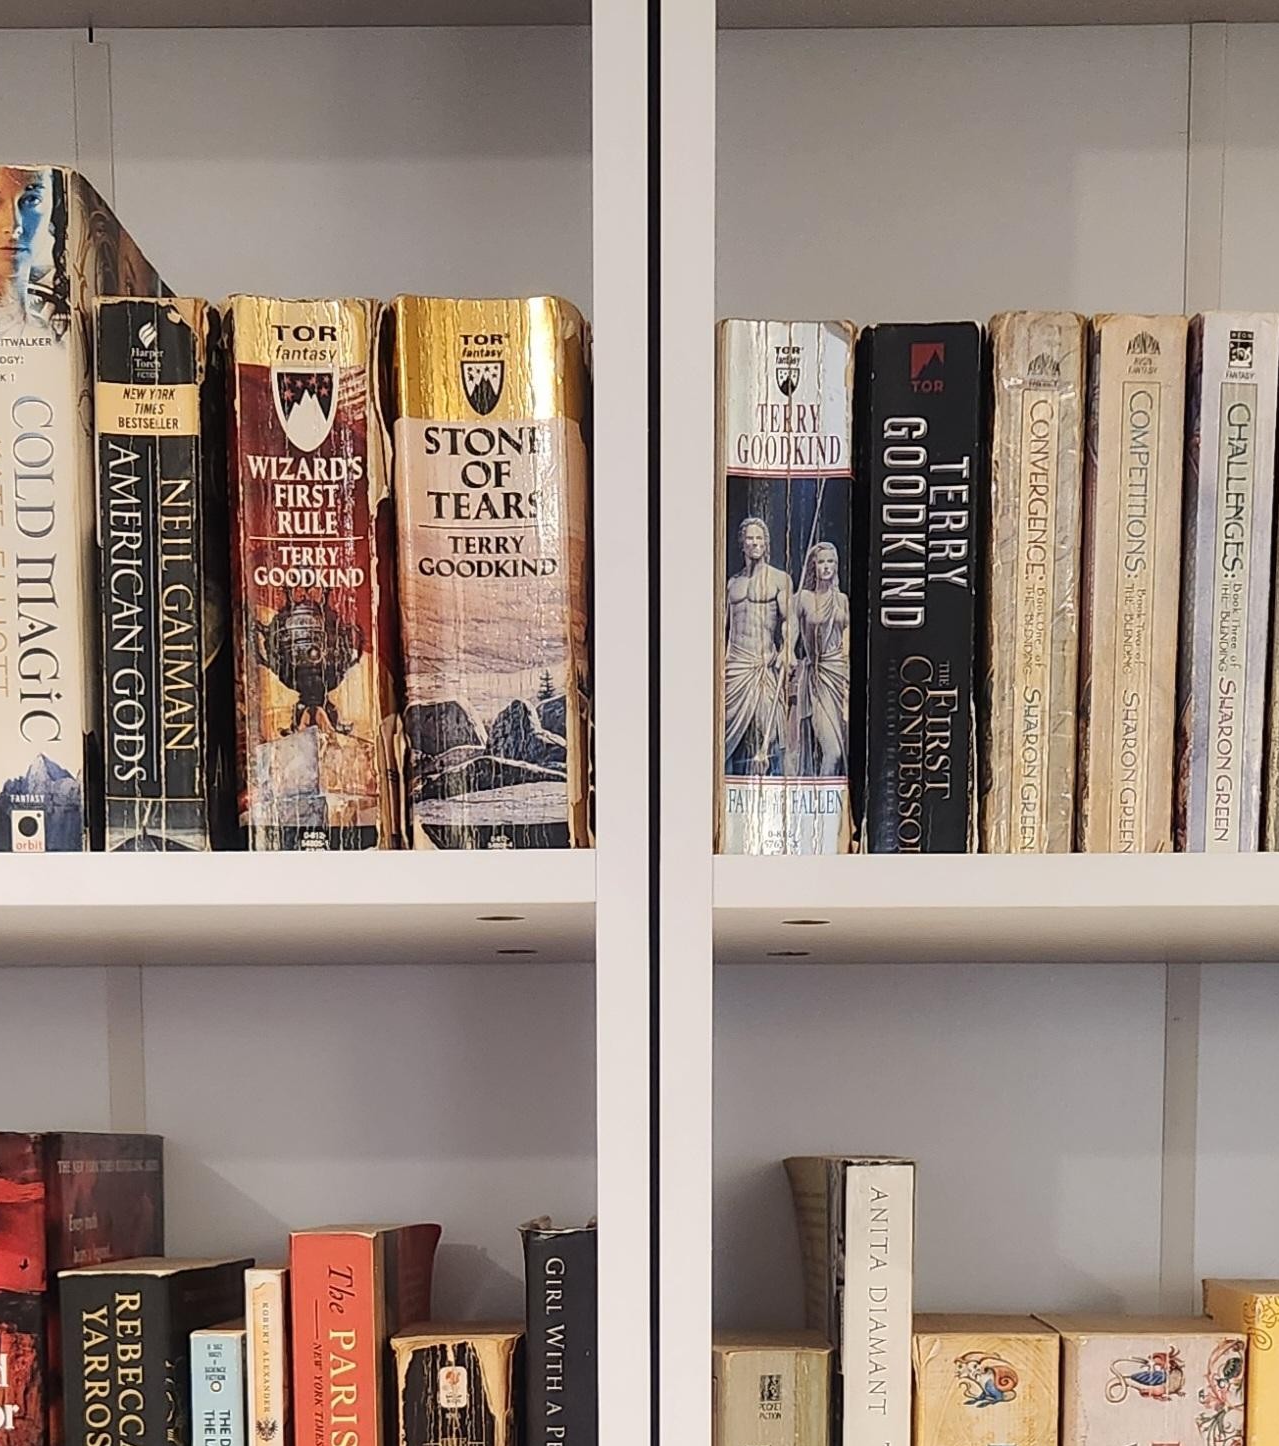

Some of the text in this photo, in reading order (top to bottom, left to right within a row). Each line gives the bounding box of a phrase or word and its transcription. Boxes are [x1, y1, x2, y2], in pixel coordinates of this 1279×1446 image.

[271, 325, 338, 343] TOR
[274, 347, 337, 362] fantasy
[11, 373, 15, 382] 1
[274, 484, 339, 508] FIRST
[880, 416, 927, 629] GOODKIND
[277, 512, 339, 535] RULE
[928, 457, 969, 590] TERRY
[254, 567, 364, 587] GOODKIND
[108, 443, 145, 783] AMERICAN GODS
[159, 478, 195, 751] NEIL GAIMAN
[870, 1185, 890, 1271] ANITA
[329, 1265, 355, 1315] The
[544, 1257, 566, 1313] GIRL
[545, 1322, 565, 1391] WITH
[868, 1285, 889, 1416] DIAMANT
[548, 1401, 560, 1416] A
